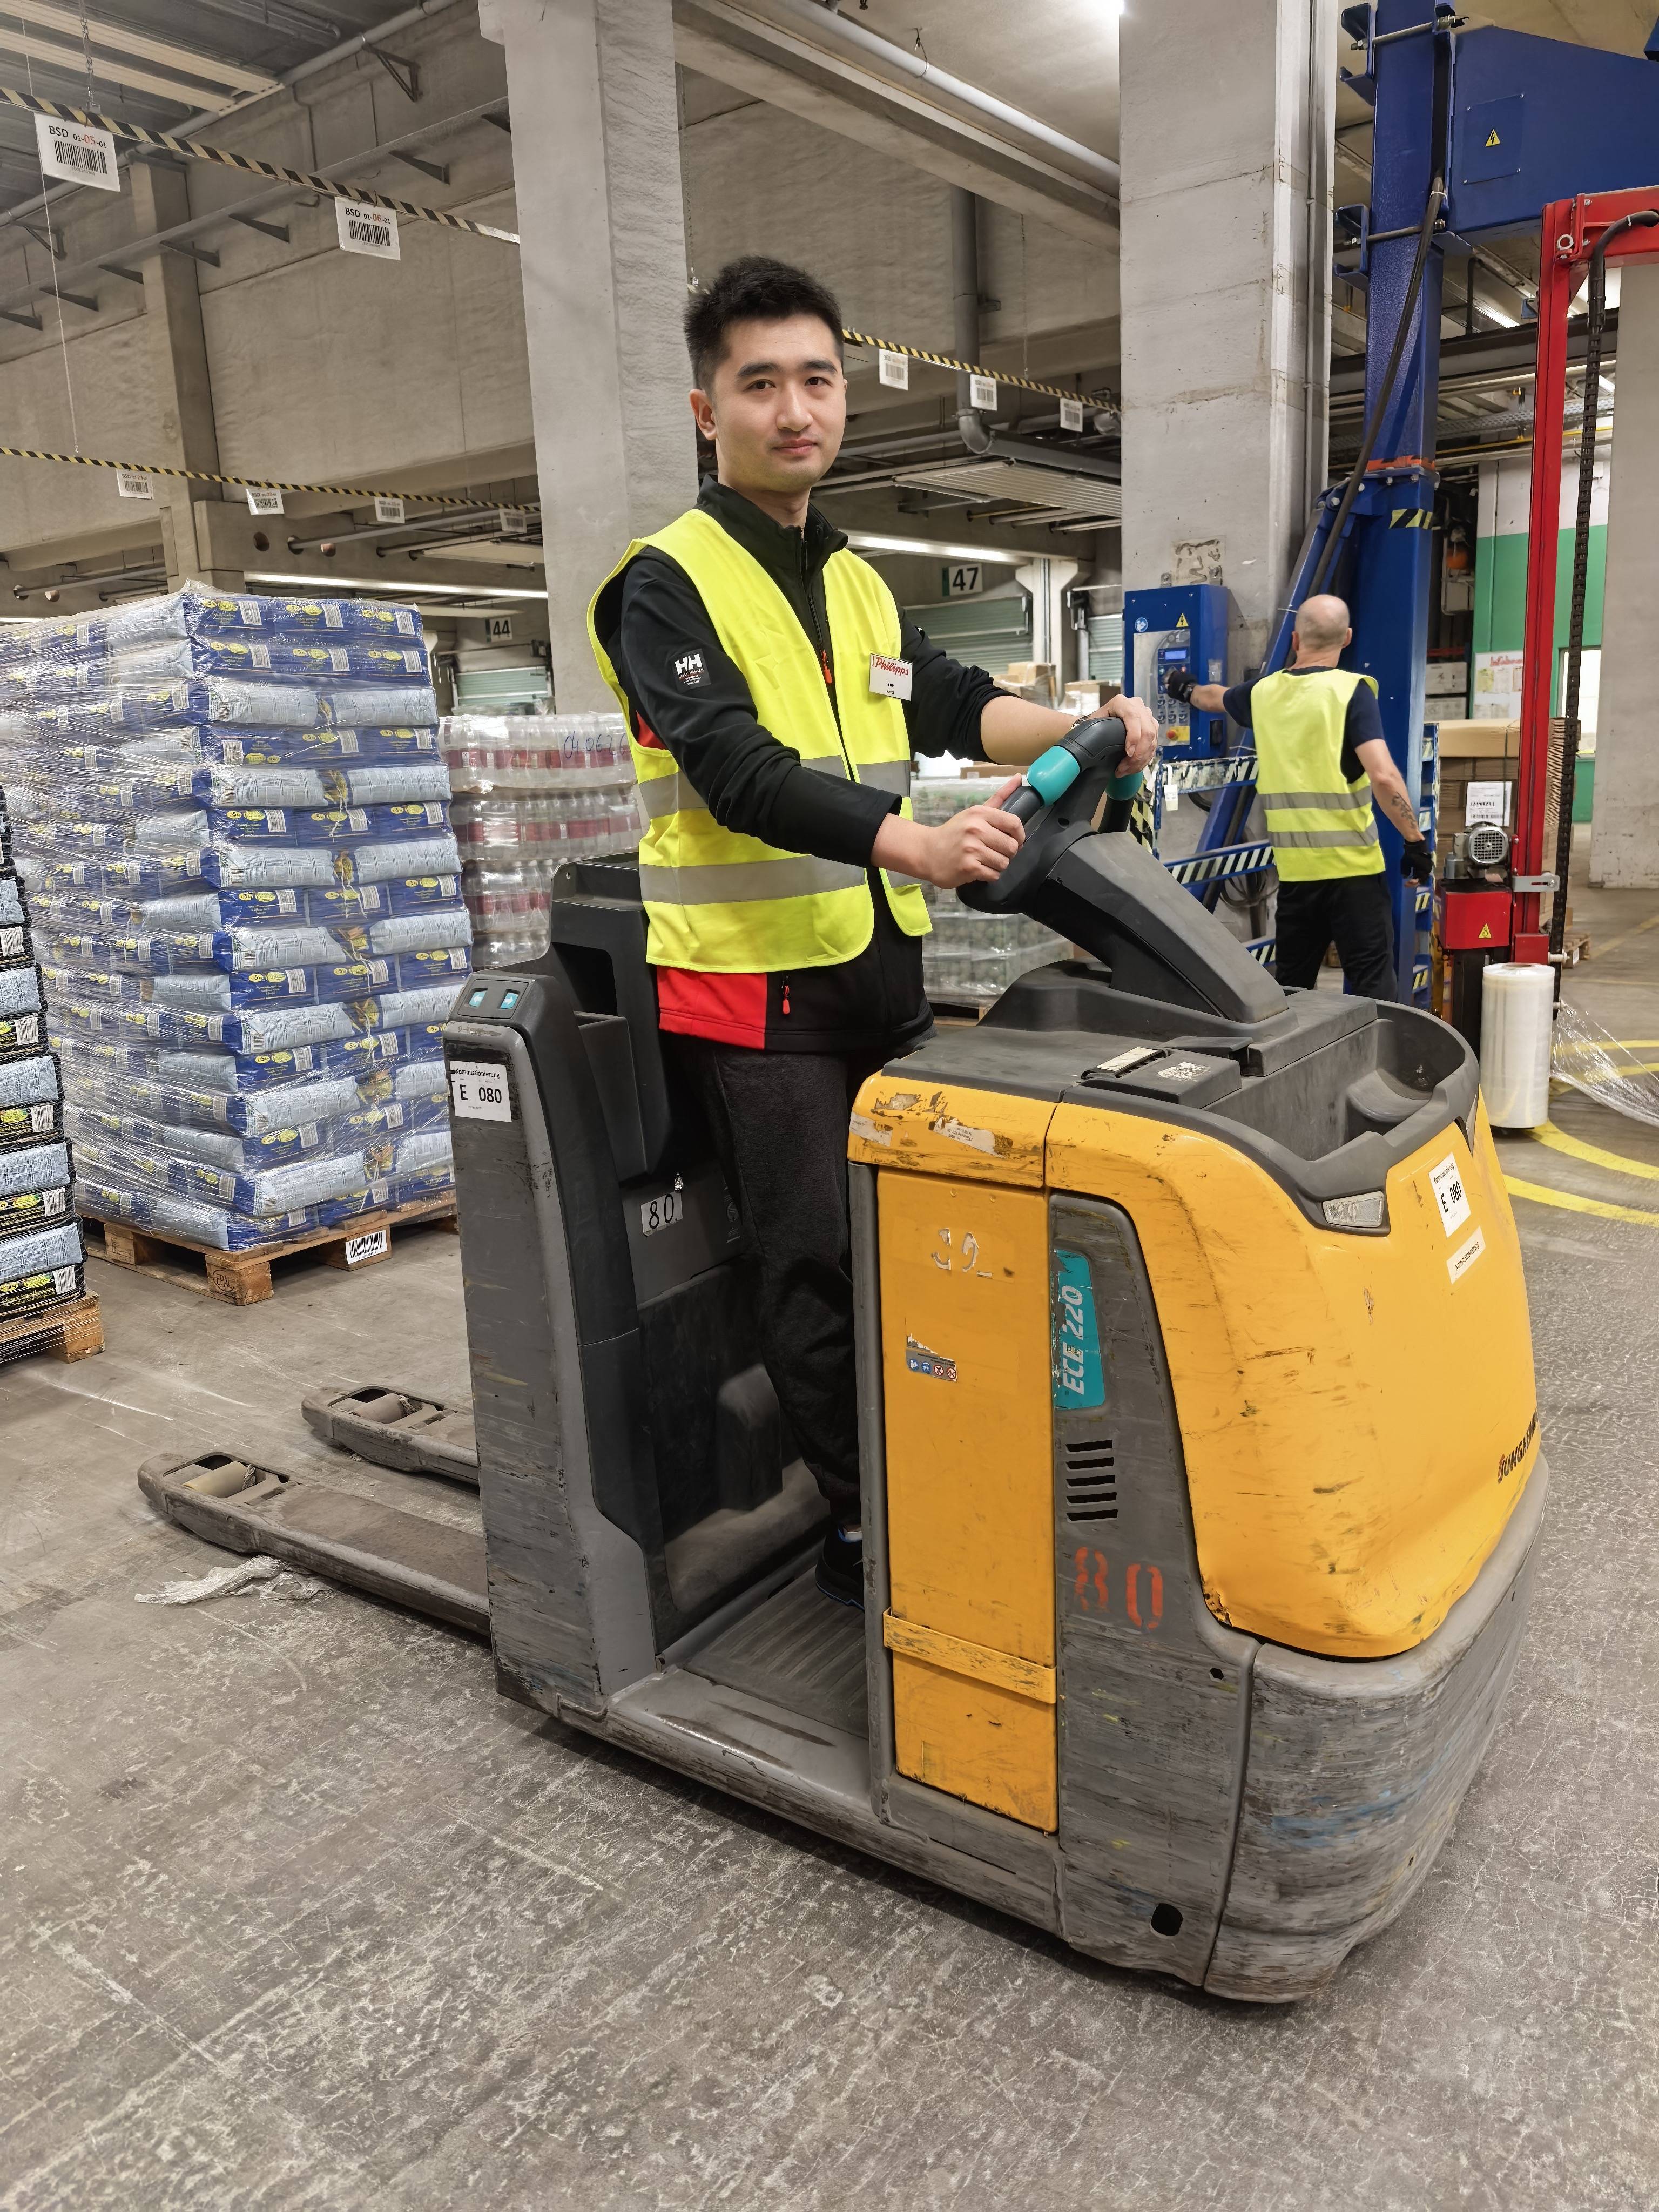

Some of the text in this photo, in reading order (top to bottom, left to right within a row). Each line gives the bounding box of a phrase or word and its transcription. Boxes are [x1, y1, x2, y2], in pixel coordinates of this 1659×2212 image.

[49, 125, 107, 148] BSD 01-05-01
[345, 207, 390, 224] BSD 01-06-01
[953, 567, 979, 591] 47
[493, 620, 510, 638] 44
[875, 657, 909, 676] Philipps
[455, 1068, 500, 1079] Kommissionierung
[460, 1084, 502, 1103] E 080
[1434, 1163, 1455, 1184] Kommissionierung
[1440, 1181, 1462, 1213] E 080
[215, 1274, 232, 1288] EPAL
[1061, 1285, 1084, 1395] ECE 220
[1074, 1546, 1163, 1631] 80
